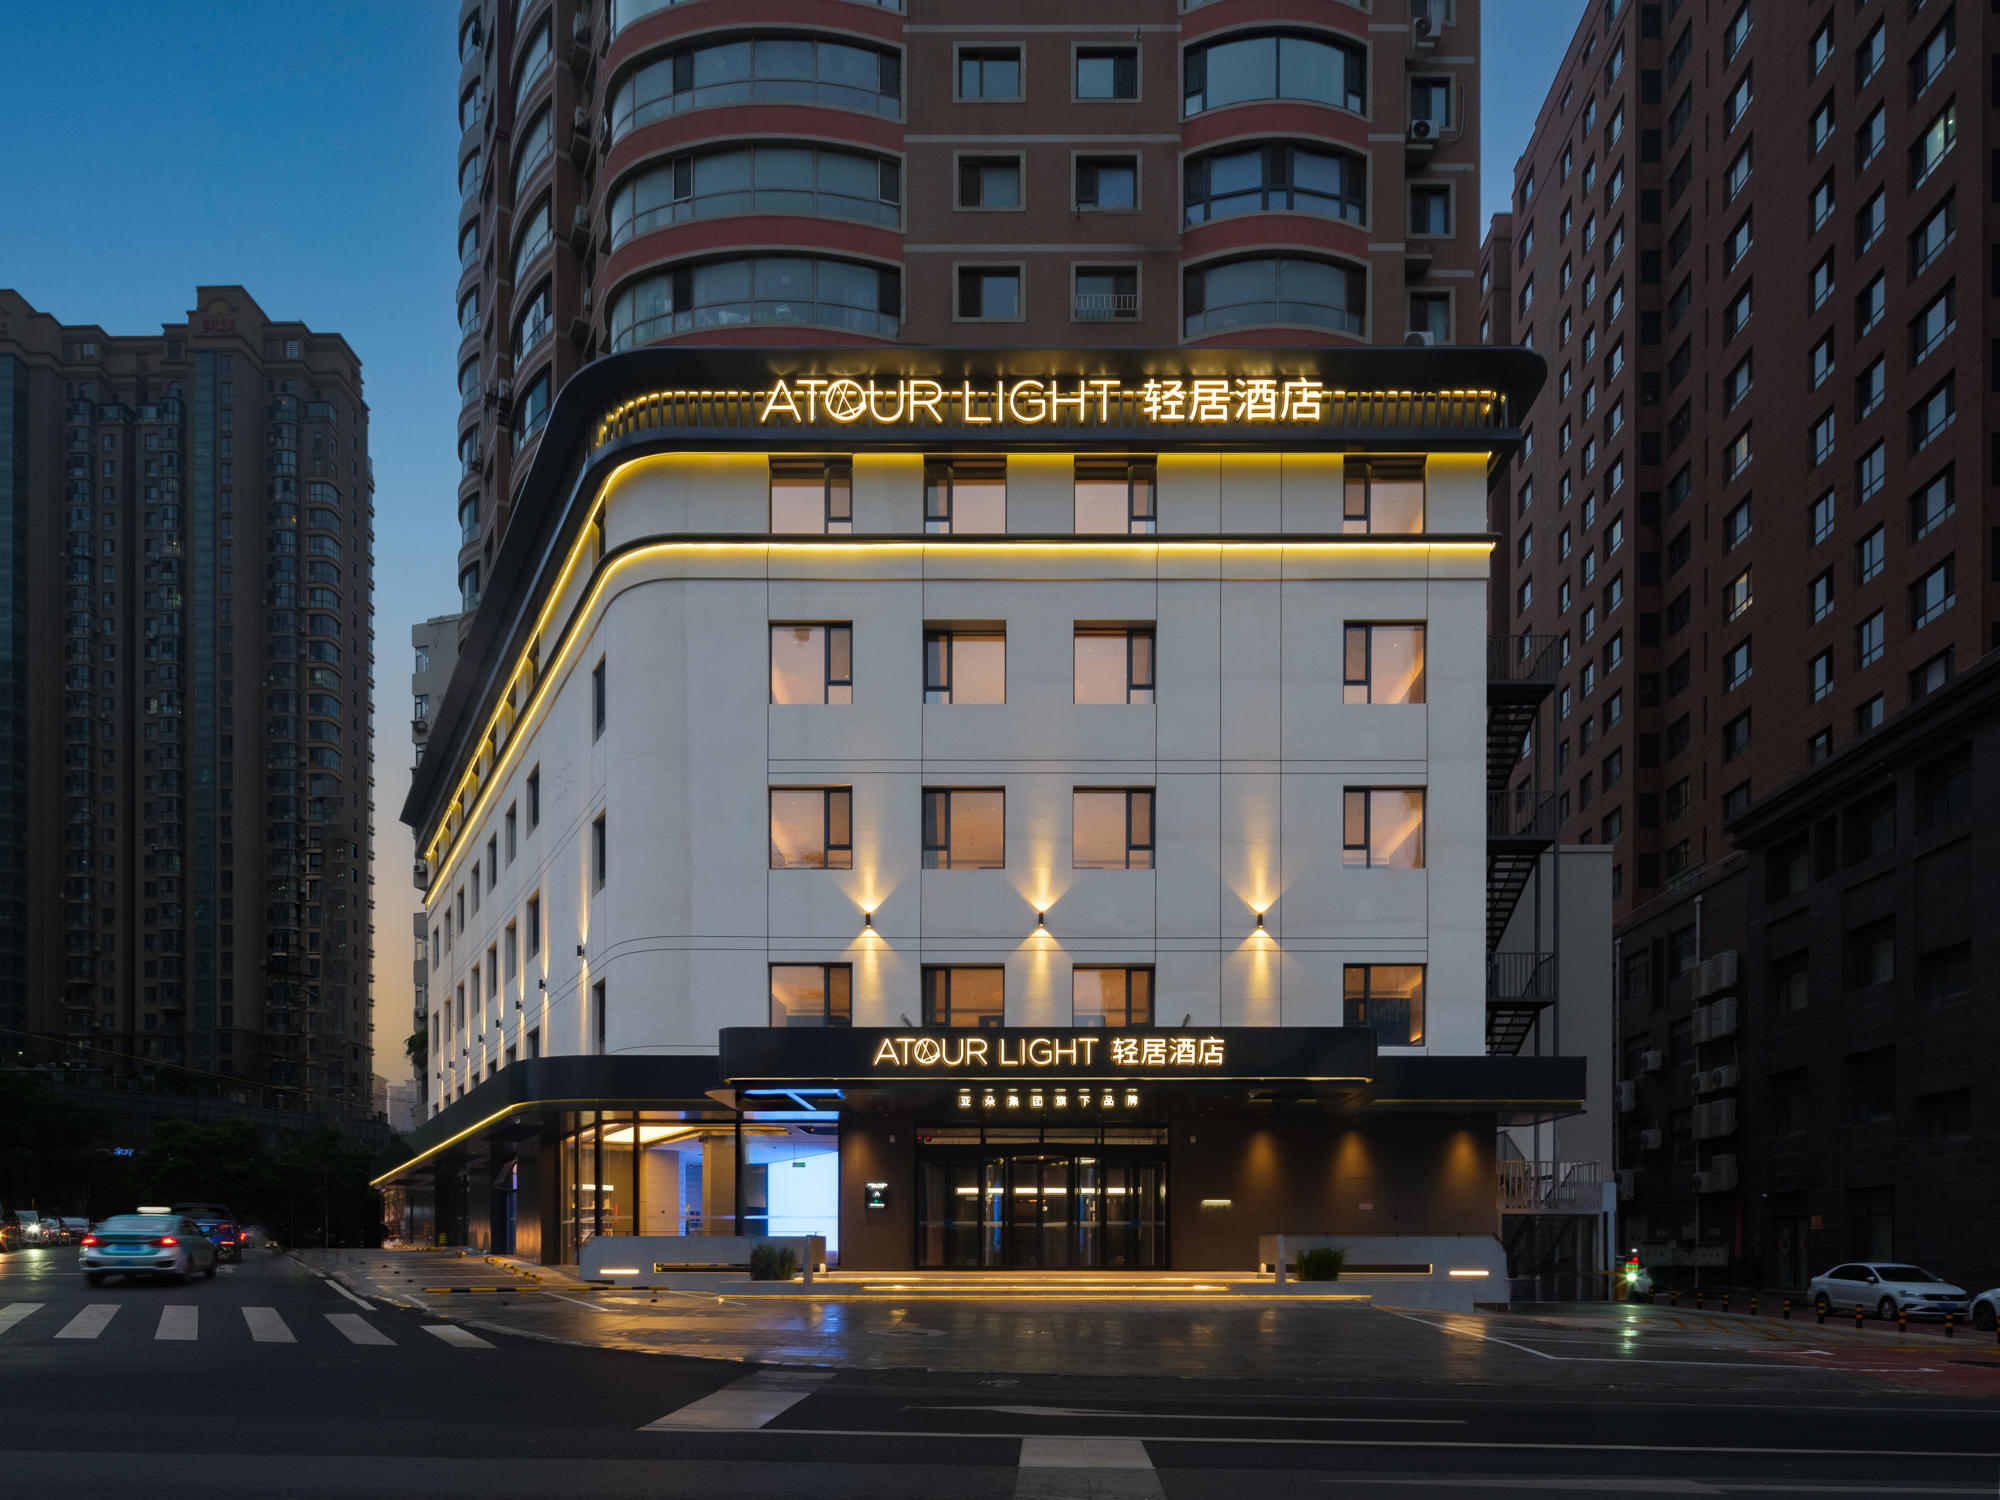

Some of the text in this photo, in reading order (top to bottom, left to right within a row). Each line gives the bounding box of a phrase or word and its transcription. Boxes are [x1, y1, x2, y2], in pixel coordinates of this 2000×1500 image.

[760, 377, 1324, 425] ATOUR LIGHT 轻居酒店
[873, 1035, 1225, 1067] ATOUR LIGHT 轻居酒店
[959, 1095, 1139, 1108] 亚朵集团旗下品牌
